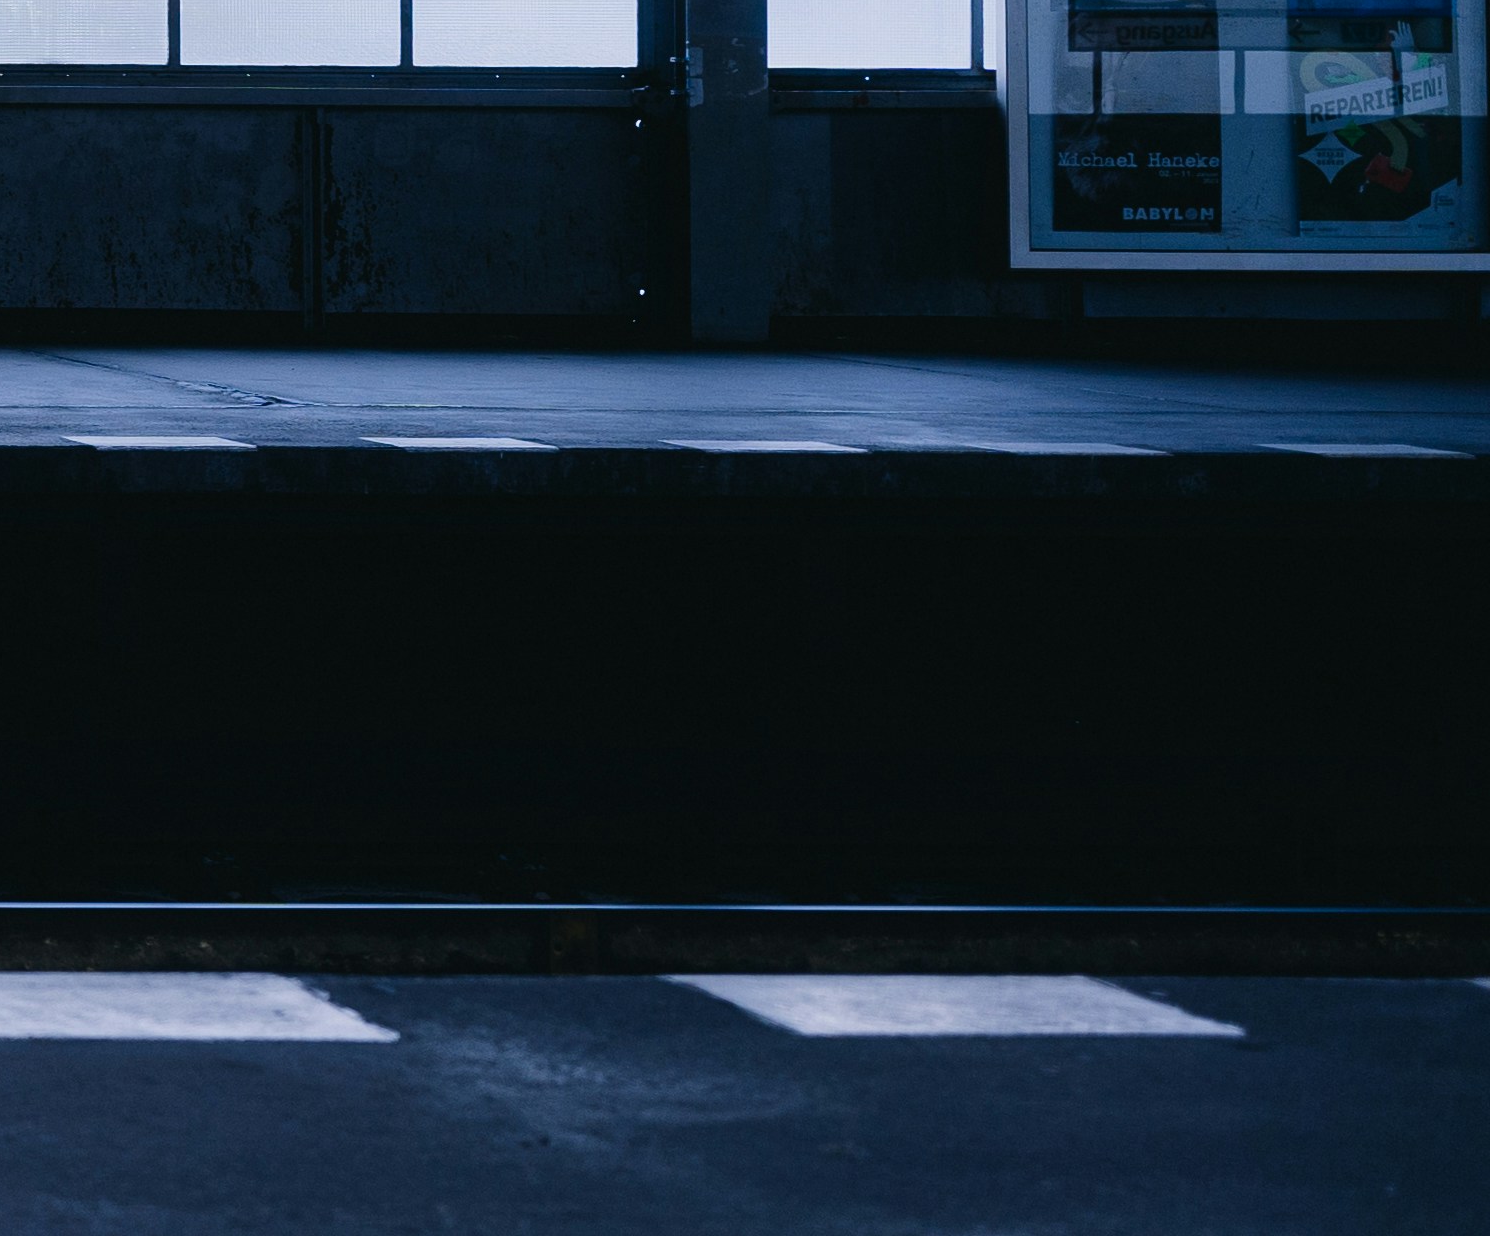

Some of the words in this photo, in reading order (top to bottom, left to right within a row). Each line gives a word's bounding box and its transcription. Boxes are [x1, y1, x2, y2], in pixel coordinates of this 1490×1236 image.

[1310, 75, 1444, 125] REPARIEREN!
[1057, 151, 1139, 168] Michael
[1147, 151, 1220, 168] Haneke
[1122, 207, 1215, 221] BABYLON
